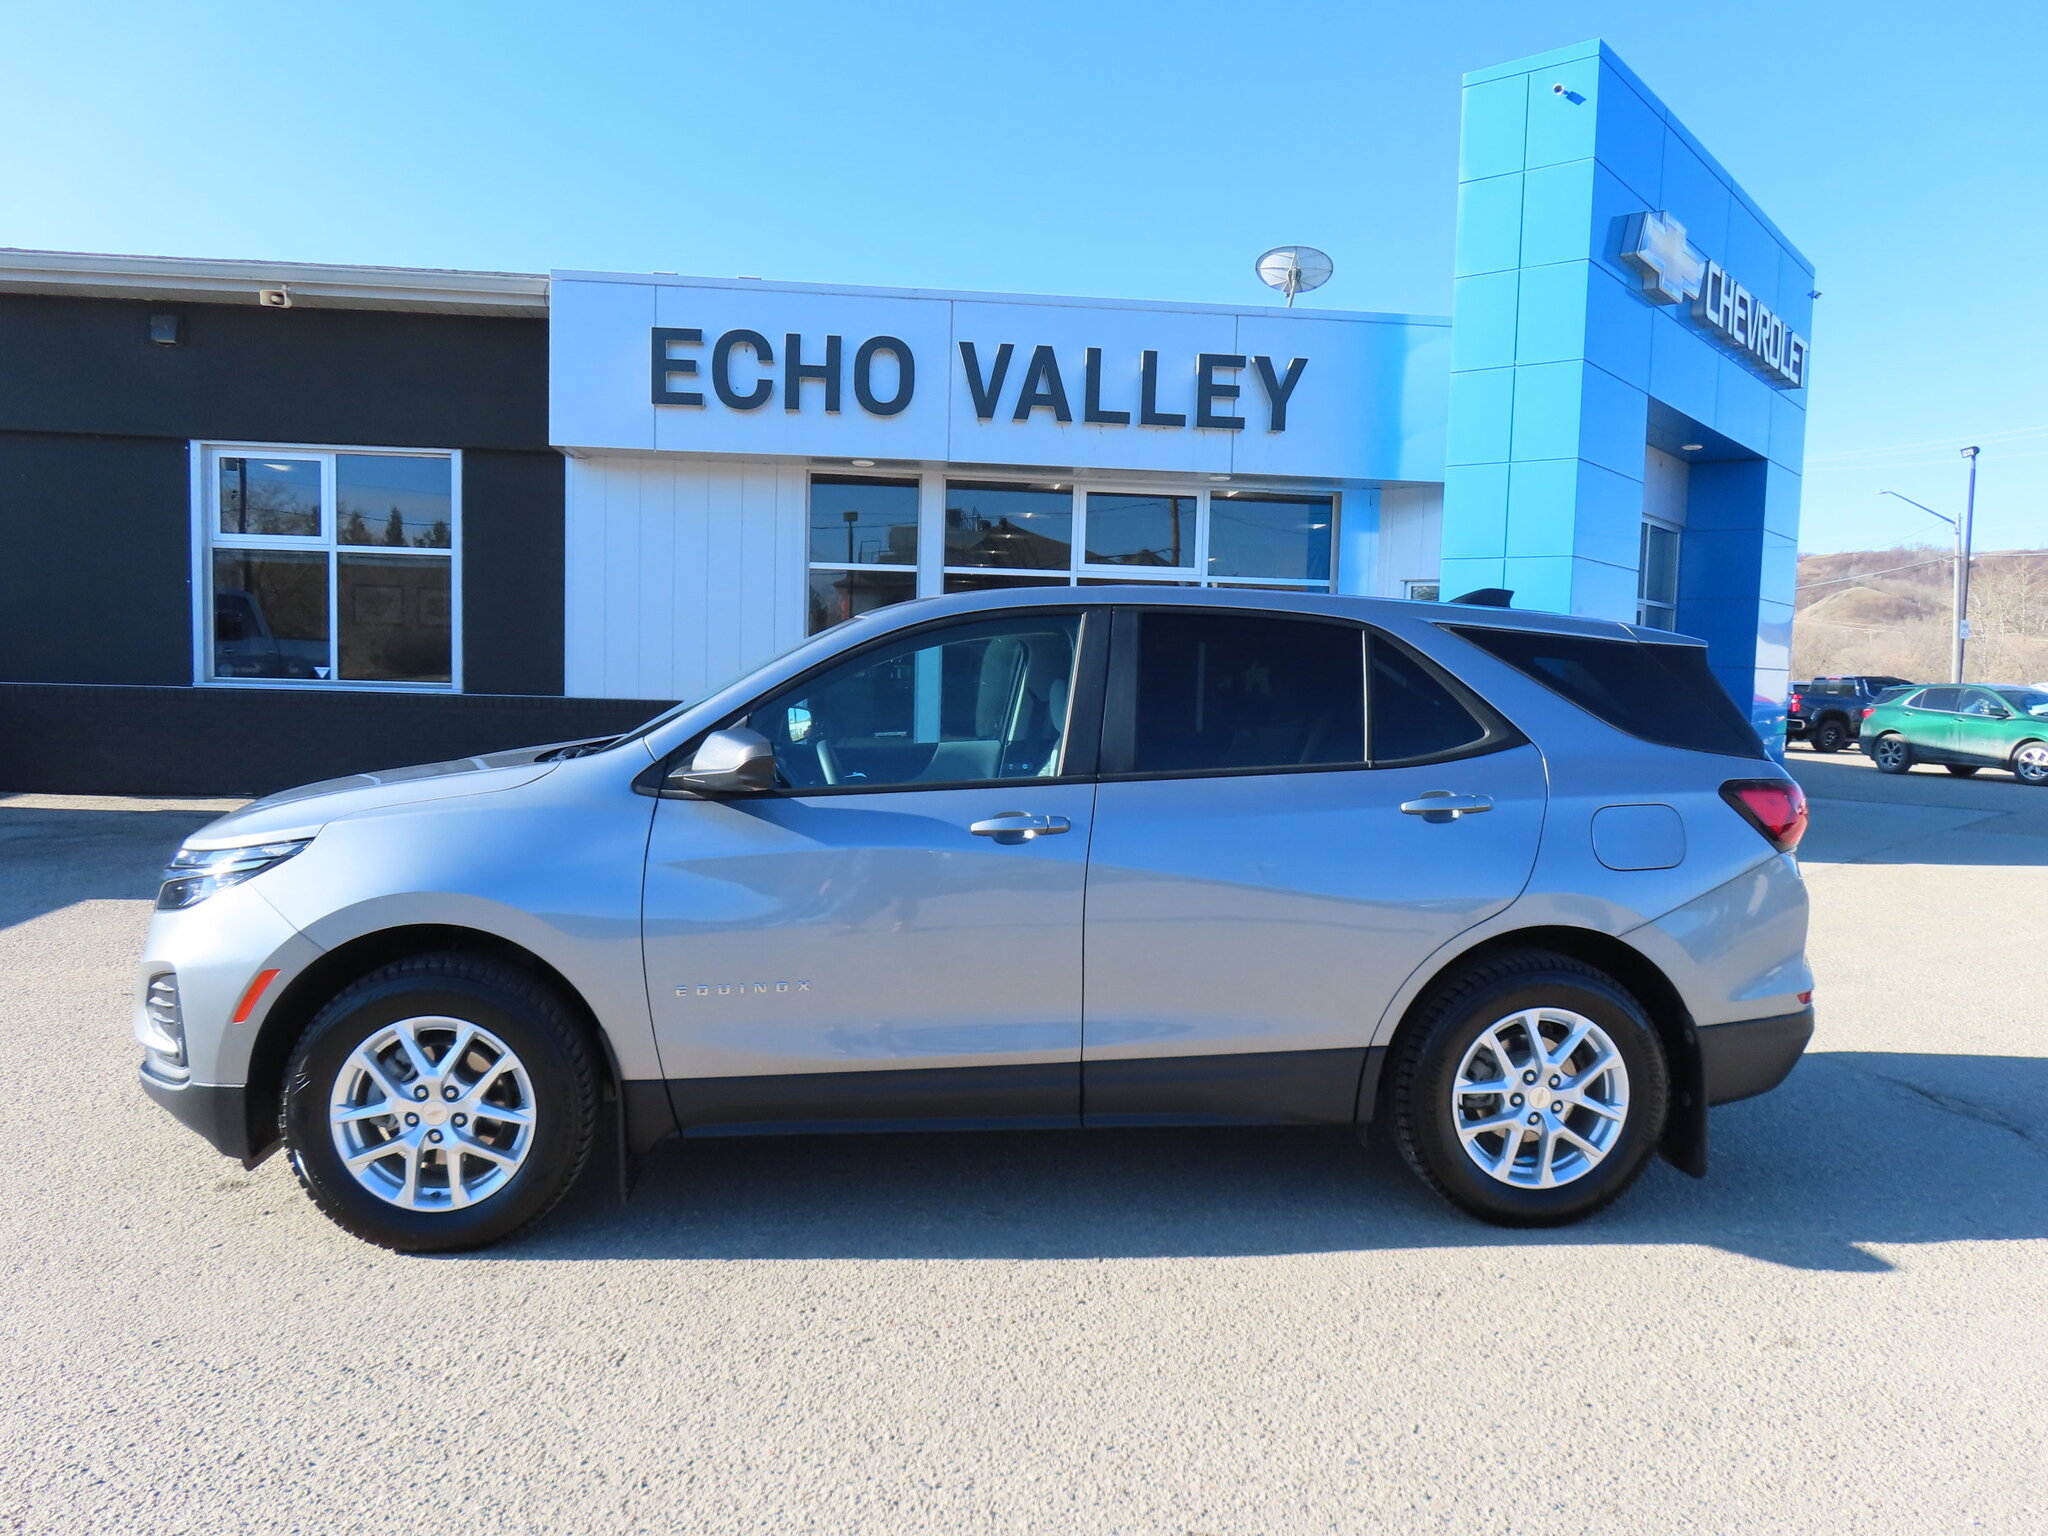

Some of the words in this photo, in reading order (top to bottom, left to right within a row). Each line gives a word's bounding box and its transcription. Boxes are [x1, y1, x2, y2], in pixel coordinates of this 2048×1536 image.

[1706, 259, 1808, 388] CHEVROLET
[651, 327, 915, 416] ECHO
[959, 341, 1308, 432] VALLEY
[675, 980, 811, 997] EQUINOX
